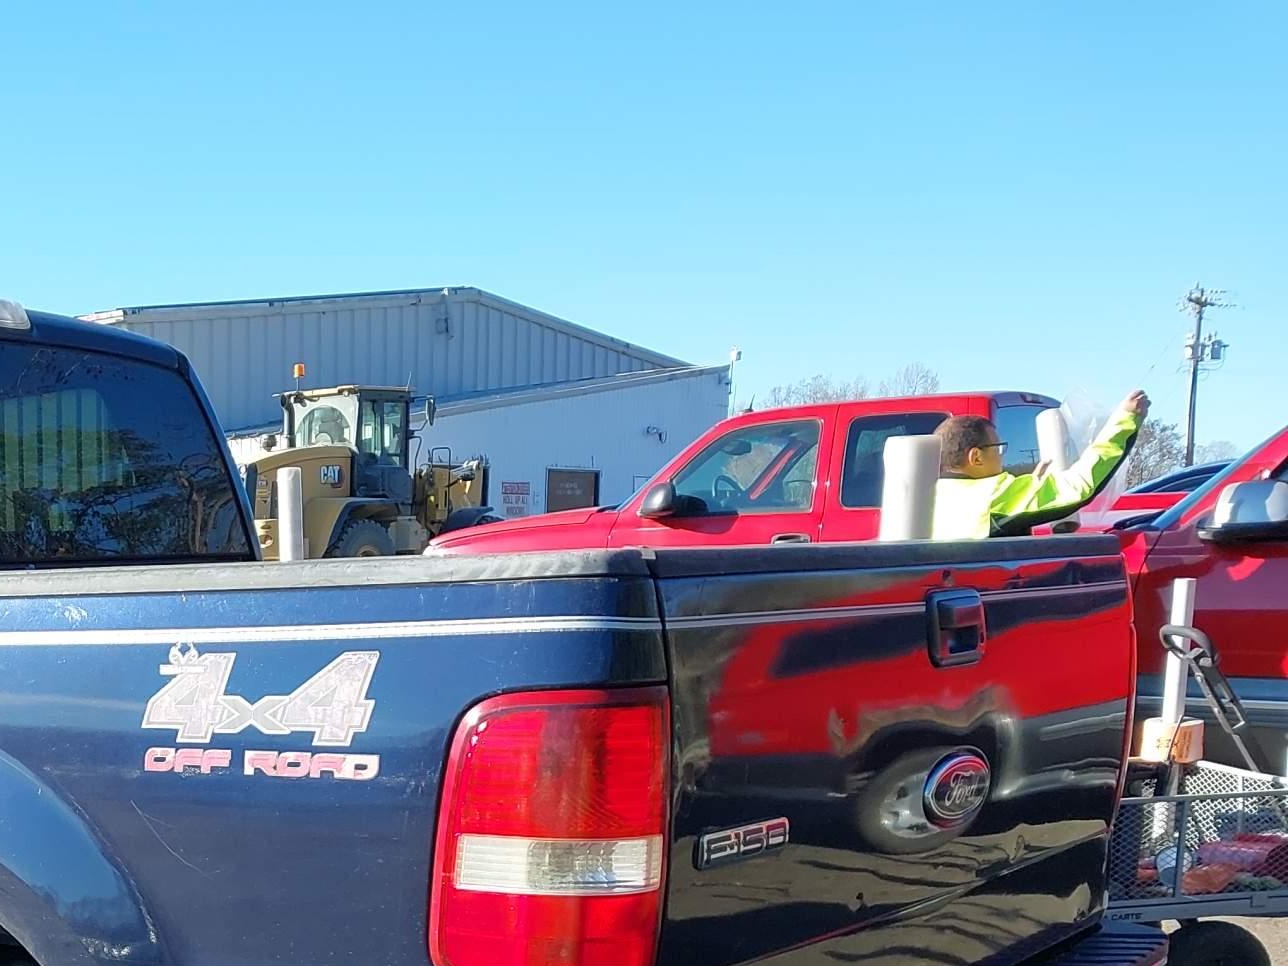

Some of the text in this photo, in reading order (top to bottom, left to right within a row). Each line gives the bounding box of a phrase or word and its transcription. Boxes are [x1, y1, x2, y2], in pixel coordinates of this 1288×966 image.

[320, 465, 340, 484] CAT
[143, 747, 381, 781] OFF ROAD
[944, 770, 981, 807] Ford
